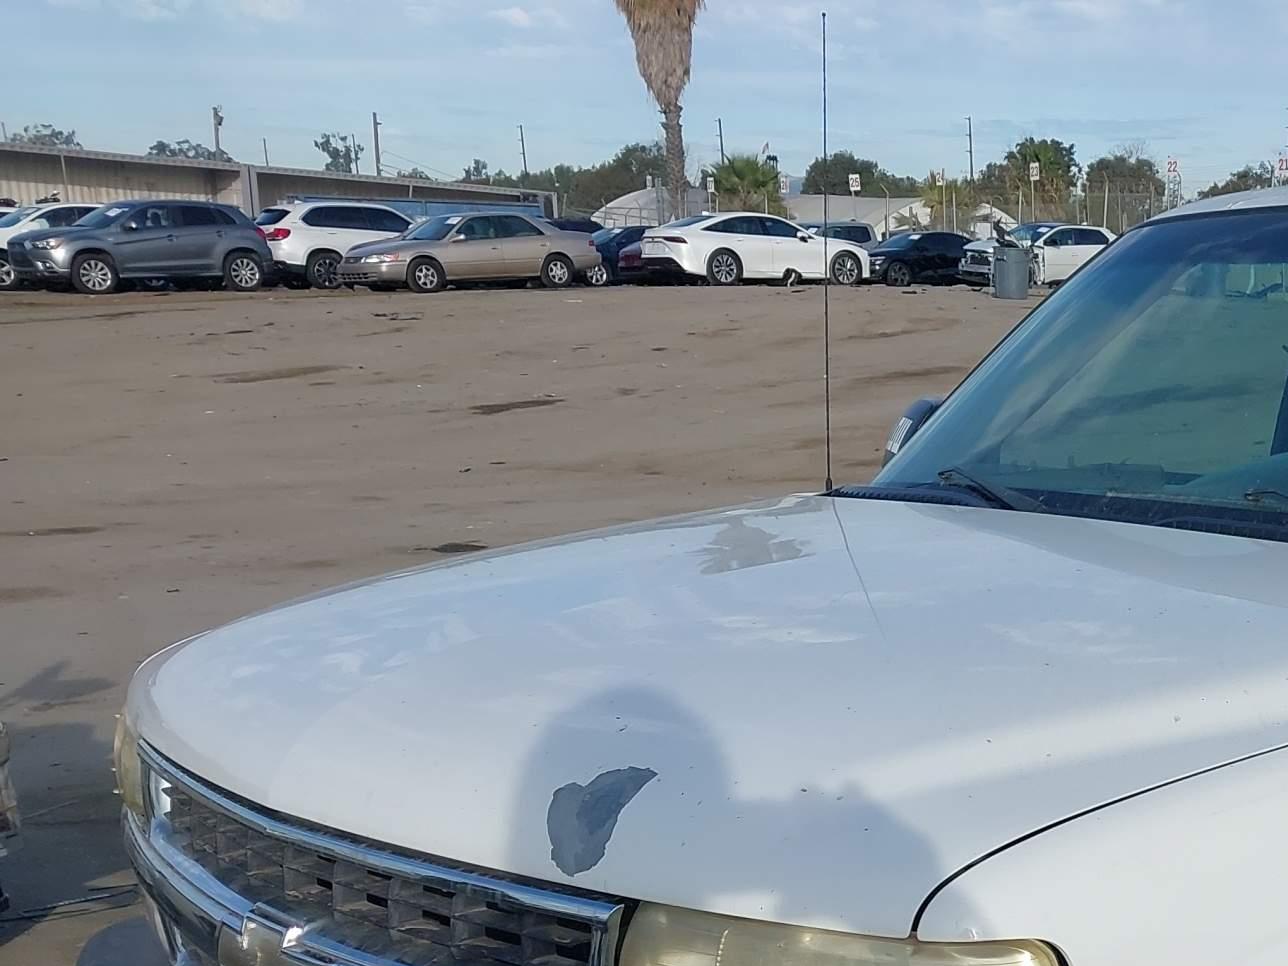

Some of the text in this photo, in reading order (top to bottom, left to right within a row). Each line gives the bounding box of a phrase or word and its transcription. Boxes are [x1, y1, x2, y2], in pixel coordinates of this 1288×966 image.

[1168, 161, 1177, 173] 22
[1278, 158, 1288, 170] 21
[1030, 166, 1039, 177] 23
